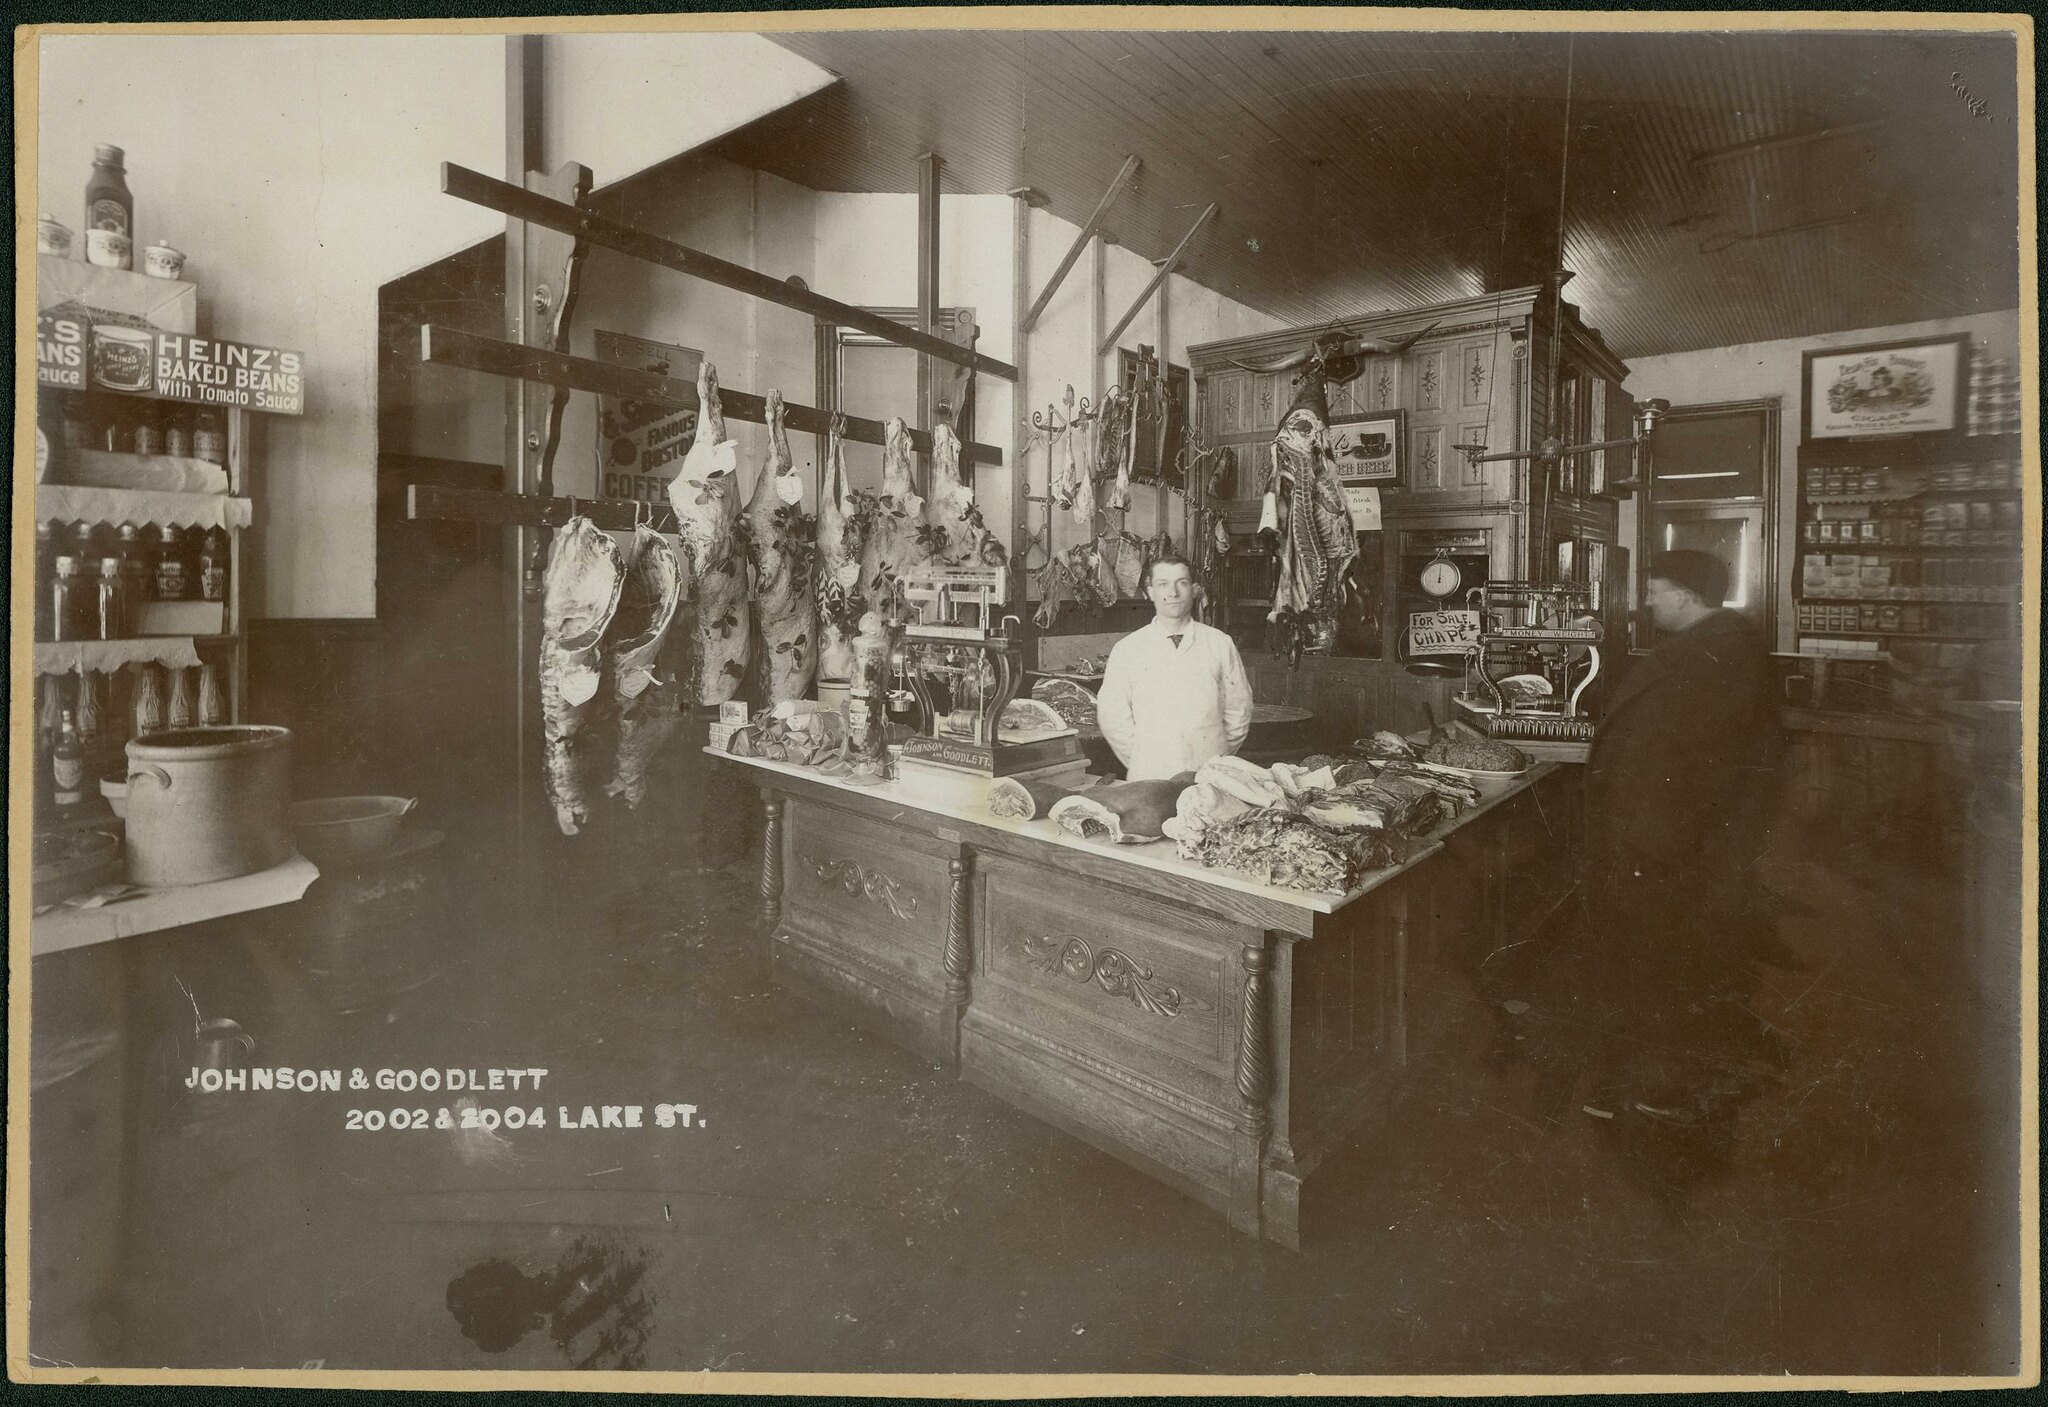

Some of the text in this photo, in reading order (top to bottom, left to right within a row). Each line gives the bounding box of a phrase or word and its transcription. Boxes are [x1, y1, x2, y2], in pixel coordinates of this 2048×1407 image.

[158, 334, 300, 374] HEINZ'S
[636, 344, 671, 363] SELL
[158, 357, 228, 385] BAKED
[235, 368, 300, 394] BEANS
[158, 379, 299, 411] With Tomato Sauce
[647, 413, 696, 448] FAMOUS
[1412, 614, 1434, 627] FOR
[1509, 629, 1589, 639] MONEY WEIGHT
[904, 740, 943, 754] JOHNSON
